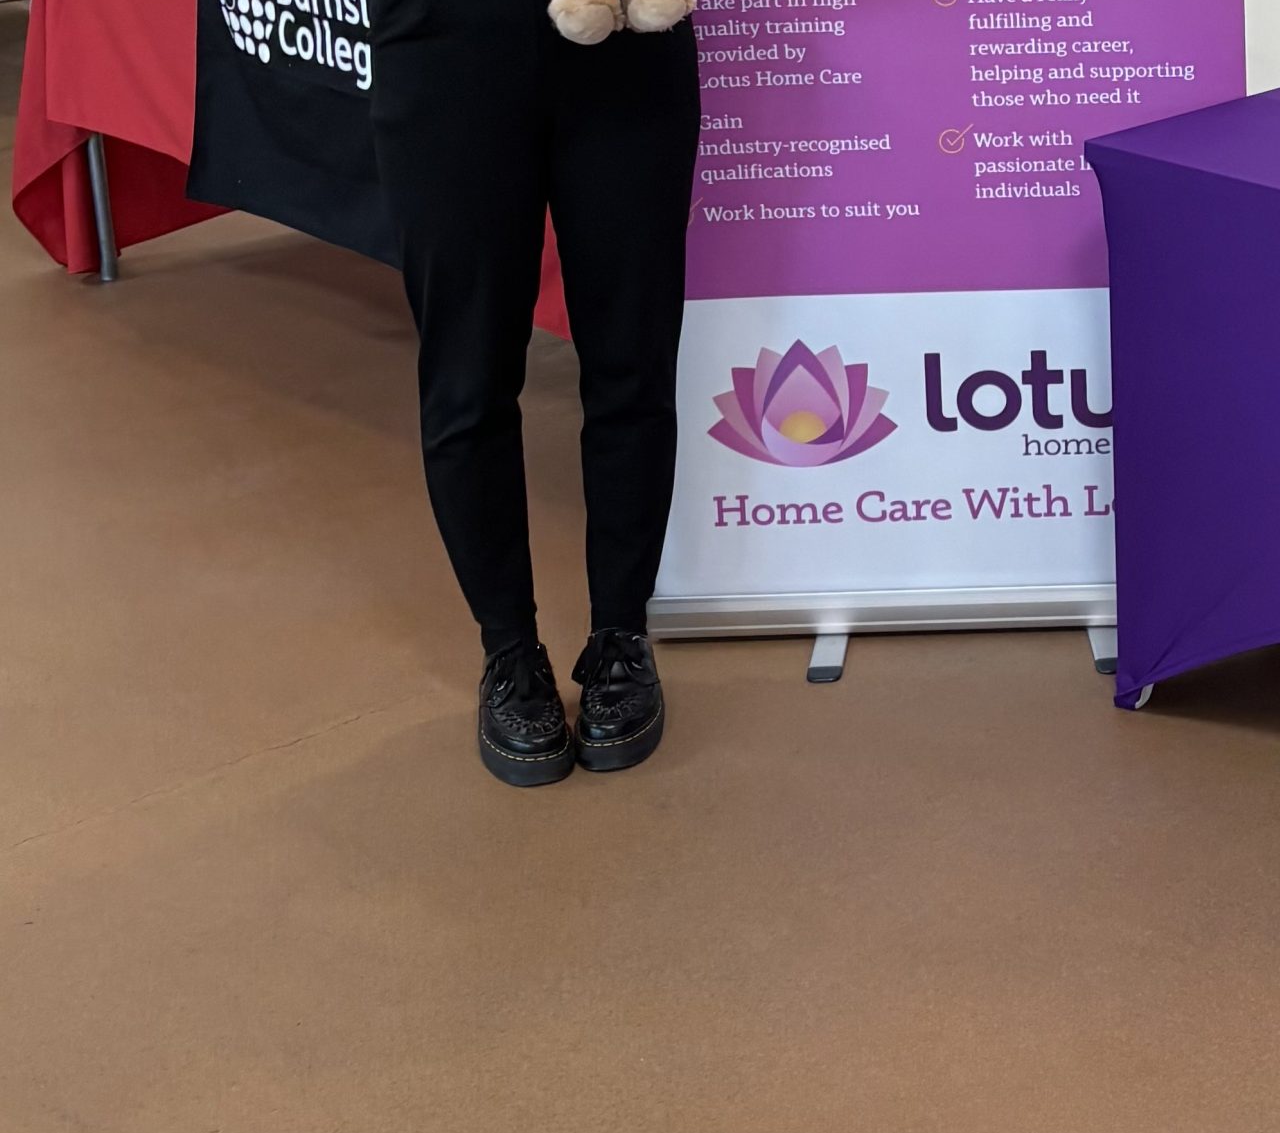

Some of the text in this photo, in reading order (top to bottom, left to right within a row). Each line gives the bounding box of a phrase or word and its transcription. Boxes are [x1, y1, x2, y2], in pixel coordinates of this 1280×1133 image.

[693, 17, 845, 40] quality training
[968, 11, 1093, 31] fulfilling and
[278, 10, 372, 90] Colleg
[784, 43, 806, 62] by
[970, 38, 1134, 56] rewarding career,
[755, 70, 814, 87] Home
[819, 69, 862, 85] Care
[970, 62, 1195, 83] helping and supporting
[972, 88, 1141, 107] those who need it
[700, 114, 743, 130] Gain
[700, 134, 891, 156] industry-recognised
[973, 130, 1073, 148] Work with
[701, 163, 833, 184] qualifications
[974, 158, 1074, 177] passionate
[975, 181, 1081, 199] individuals
[703, 201, 920, 222] Work hours to suit you
[924, 350, 1113, 432] lotu
[1022, 434, 1111, 456] home
[713, 494, 844, 527] Home
[855, 490, 952, 524] Care
[963, 484, 1072, 519] With
